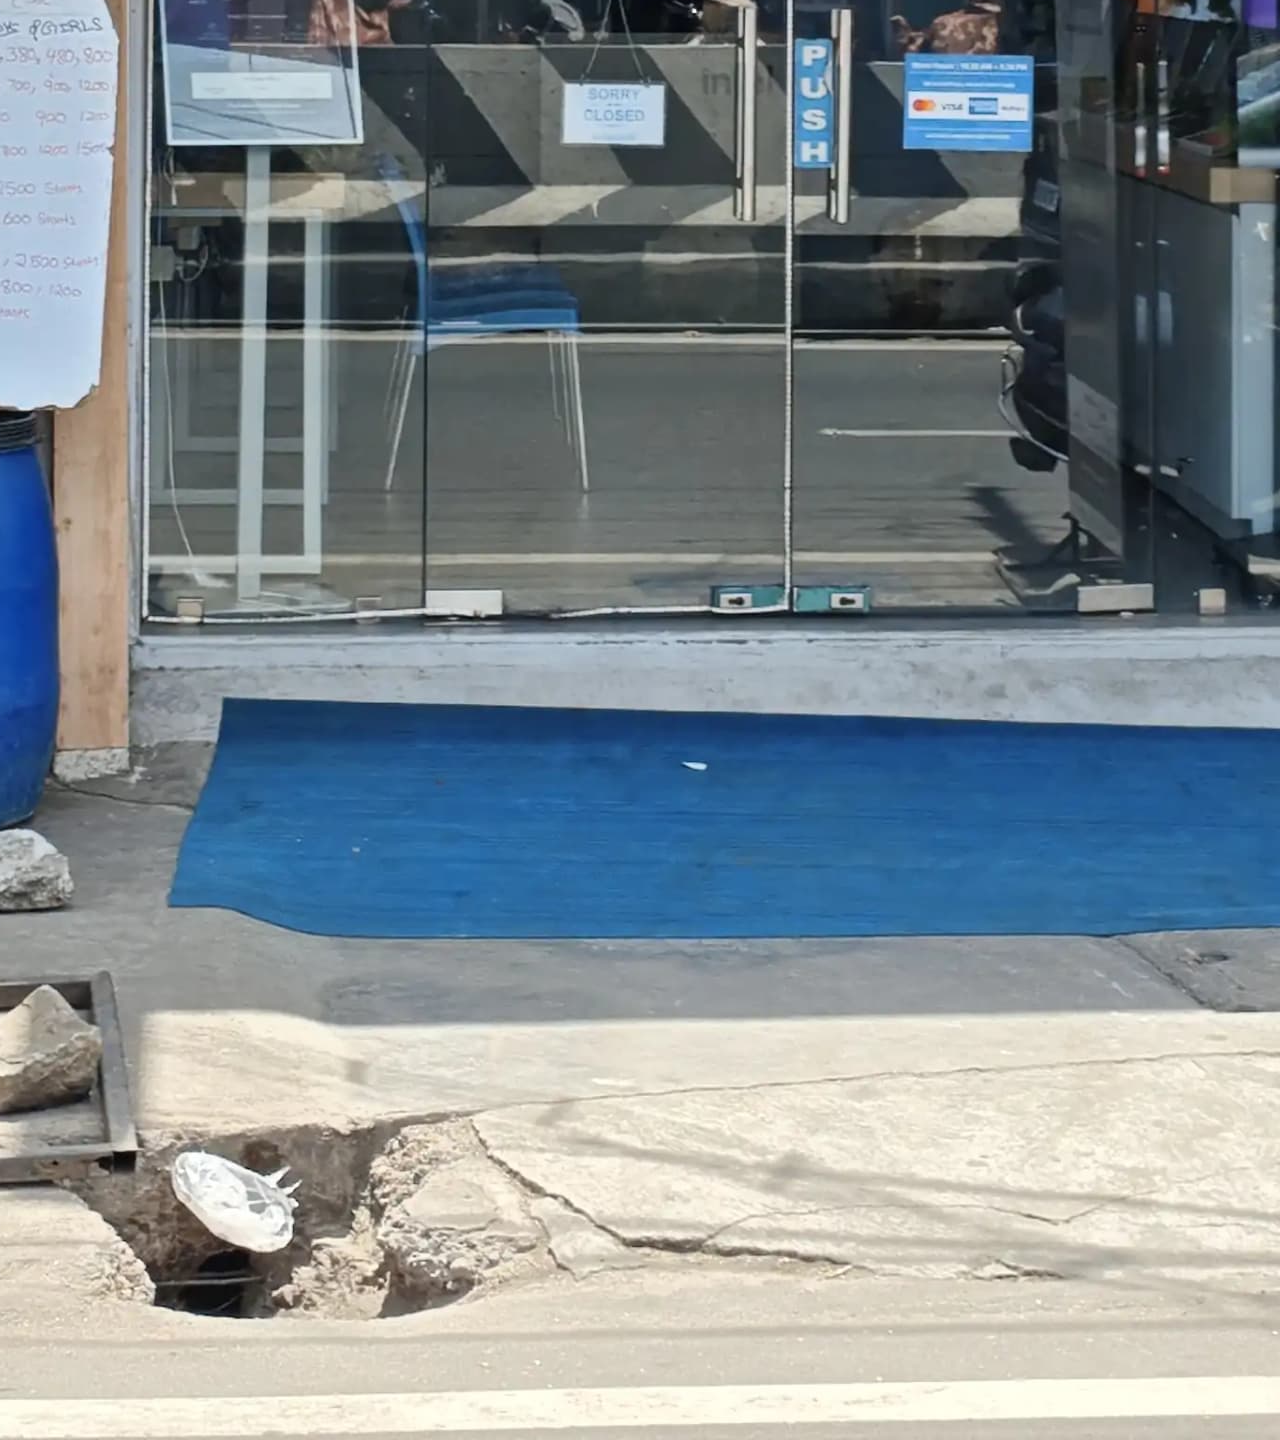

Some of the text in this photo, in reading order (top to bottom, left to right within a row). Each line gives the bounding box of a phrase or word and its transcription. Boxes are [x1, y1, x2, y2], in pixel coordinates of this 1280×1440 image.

[588, 88, 639, 101] SORRY
[801, 46, 829, 163] PUSH
[584, 109, 645, 122] CLOSED
